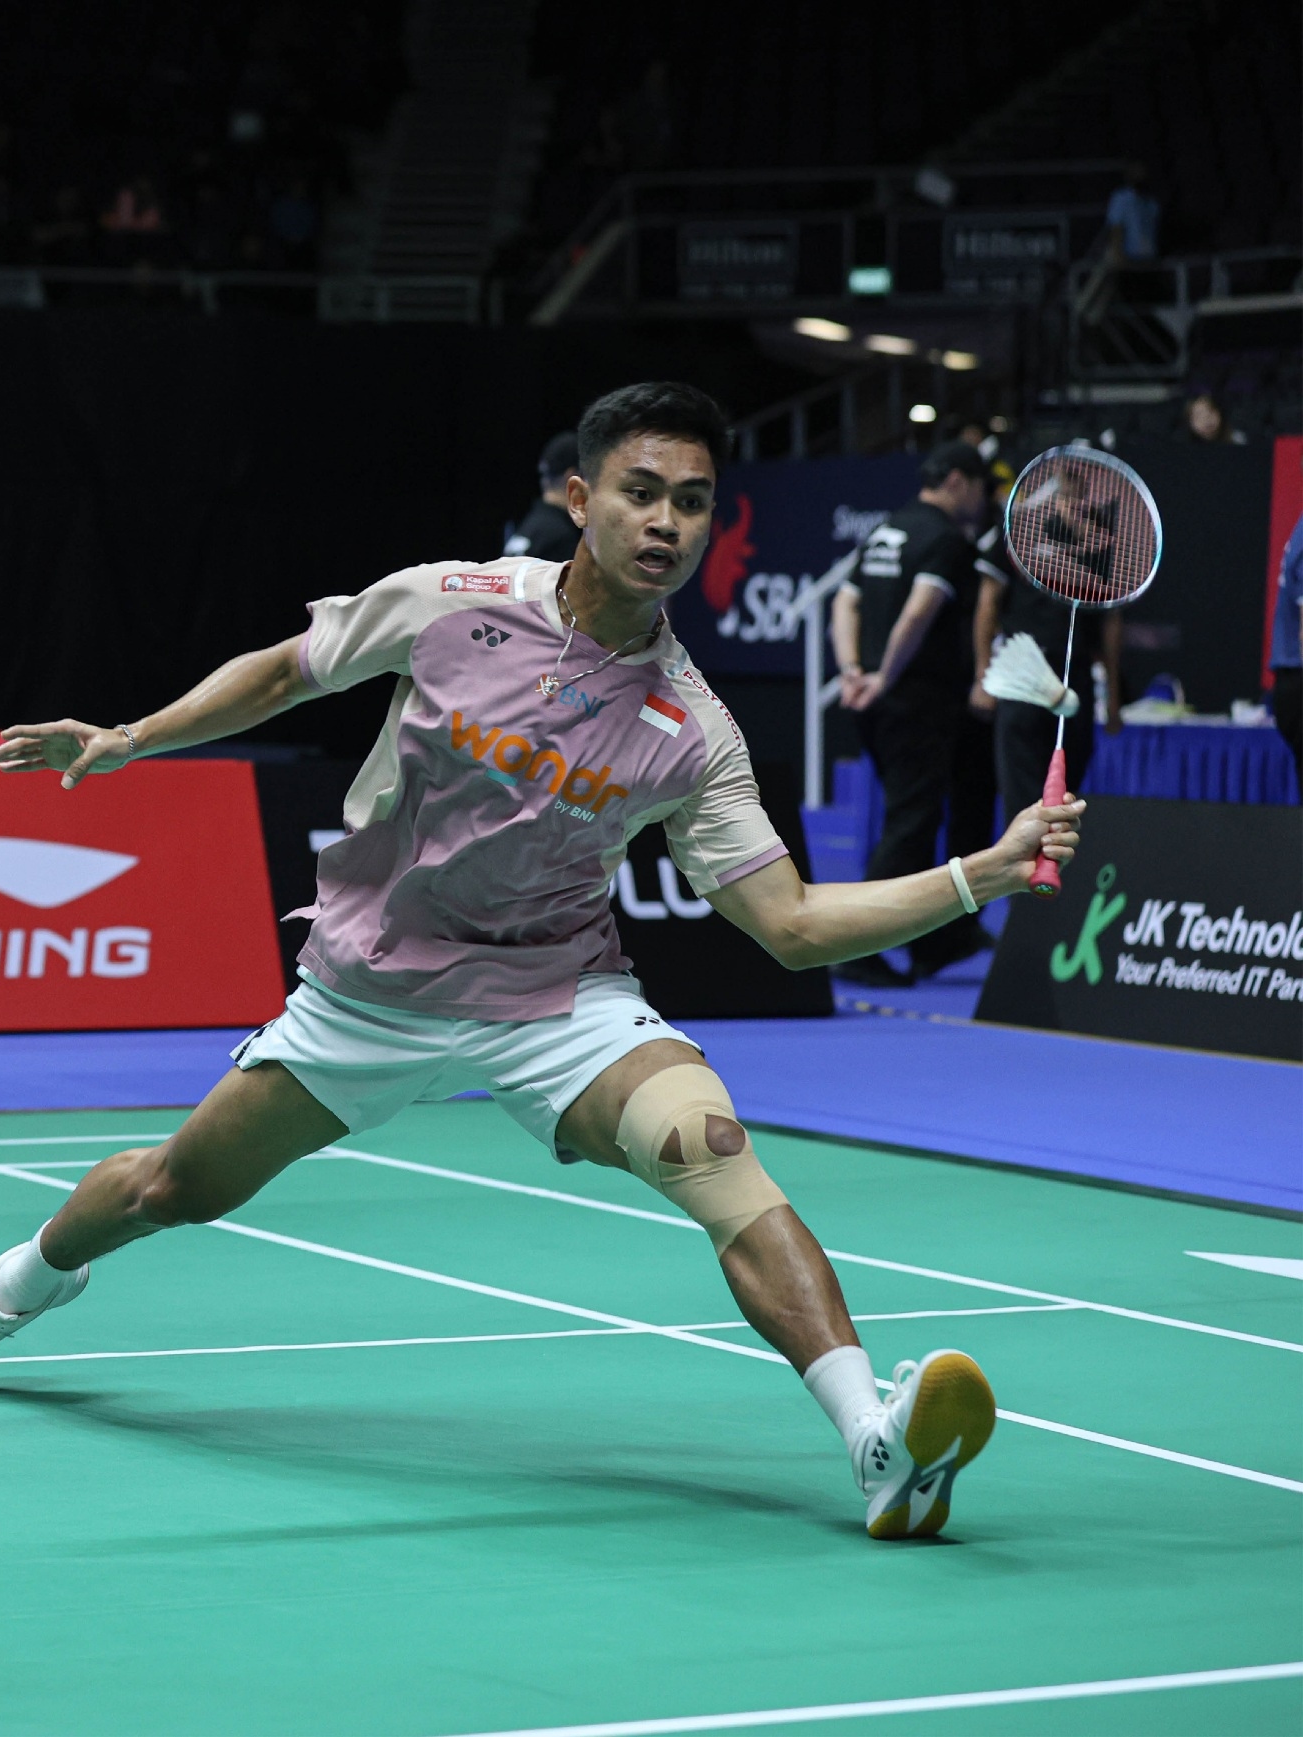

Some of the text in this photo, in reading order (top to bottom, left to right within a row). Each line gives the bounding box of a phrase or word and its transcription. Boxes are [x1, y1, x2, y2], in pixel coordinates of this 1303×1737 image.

[466, 576, 493, 584] Kapal
[559, 684, 606, 719] BNI
[452, 710, 629, 813] wondr
[554, 799, 596, 823] by BNI
[608, 856, 714, 920] LU
[1123, 899, 1177, 948] JK
[1115, 952, 1158, 986] Your
[1155, 956, 1247, 996] Preferred
[1243, 965, 1272, 998] IT
